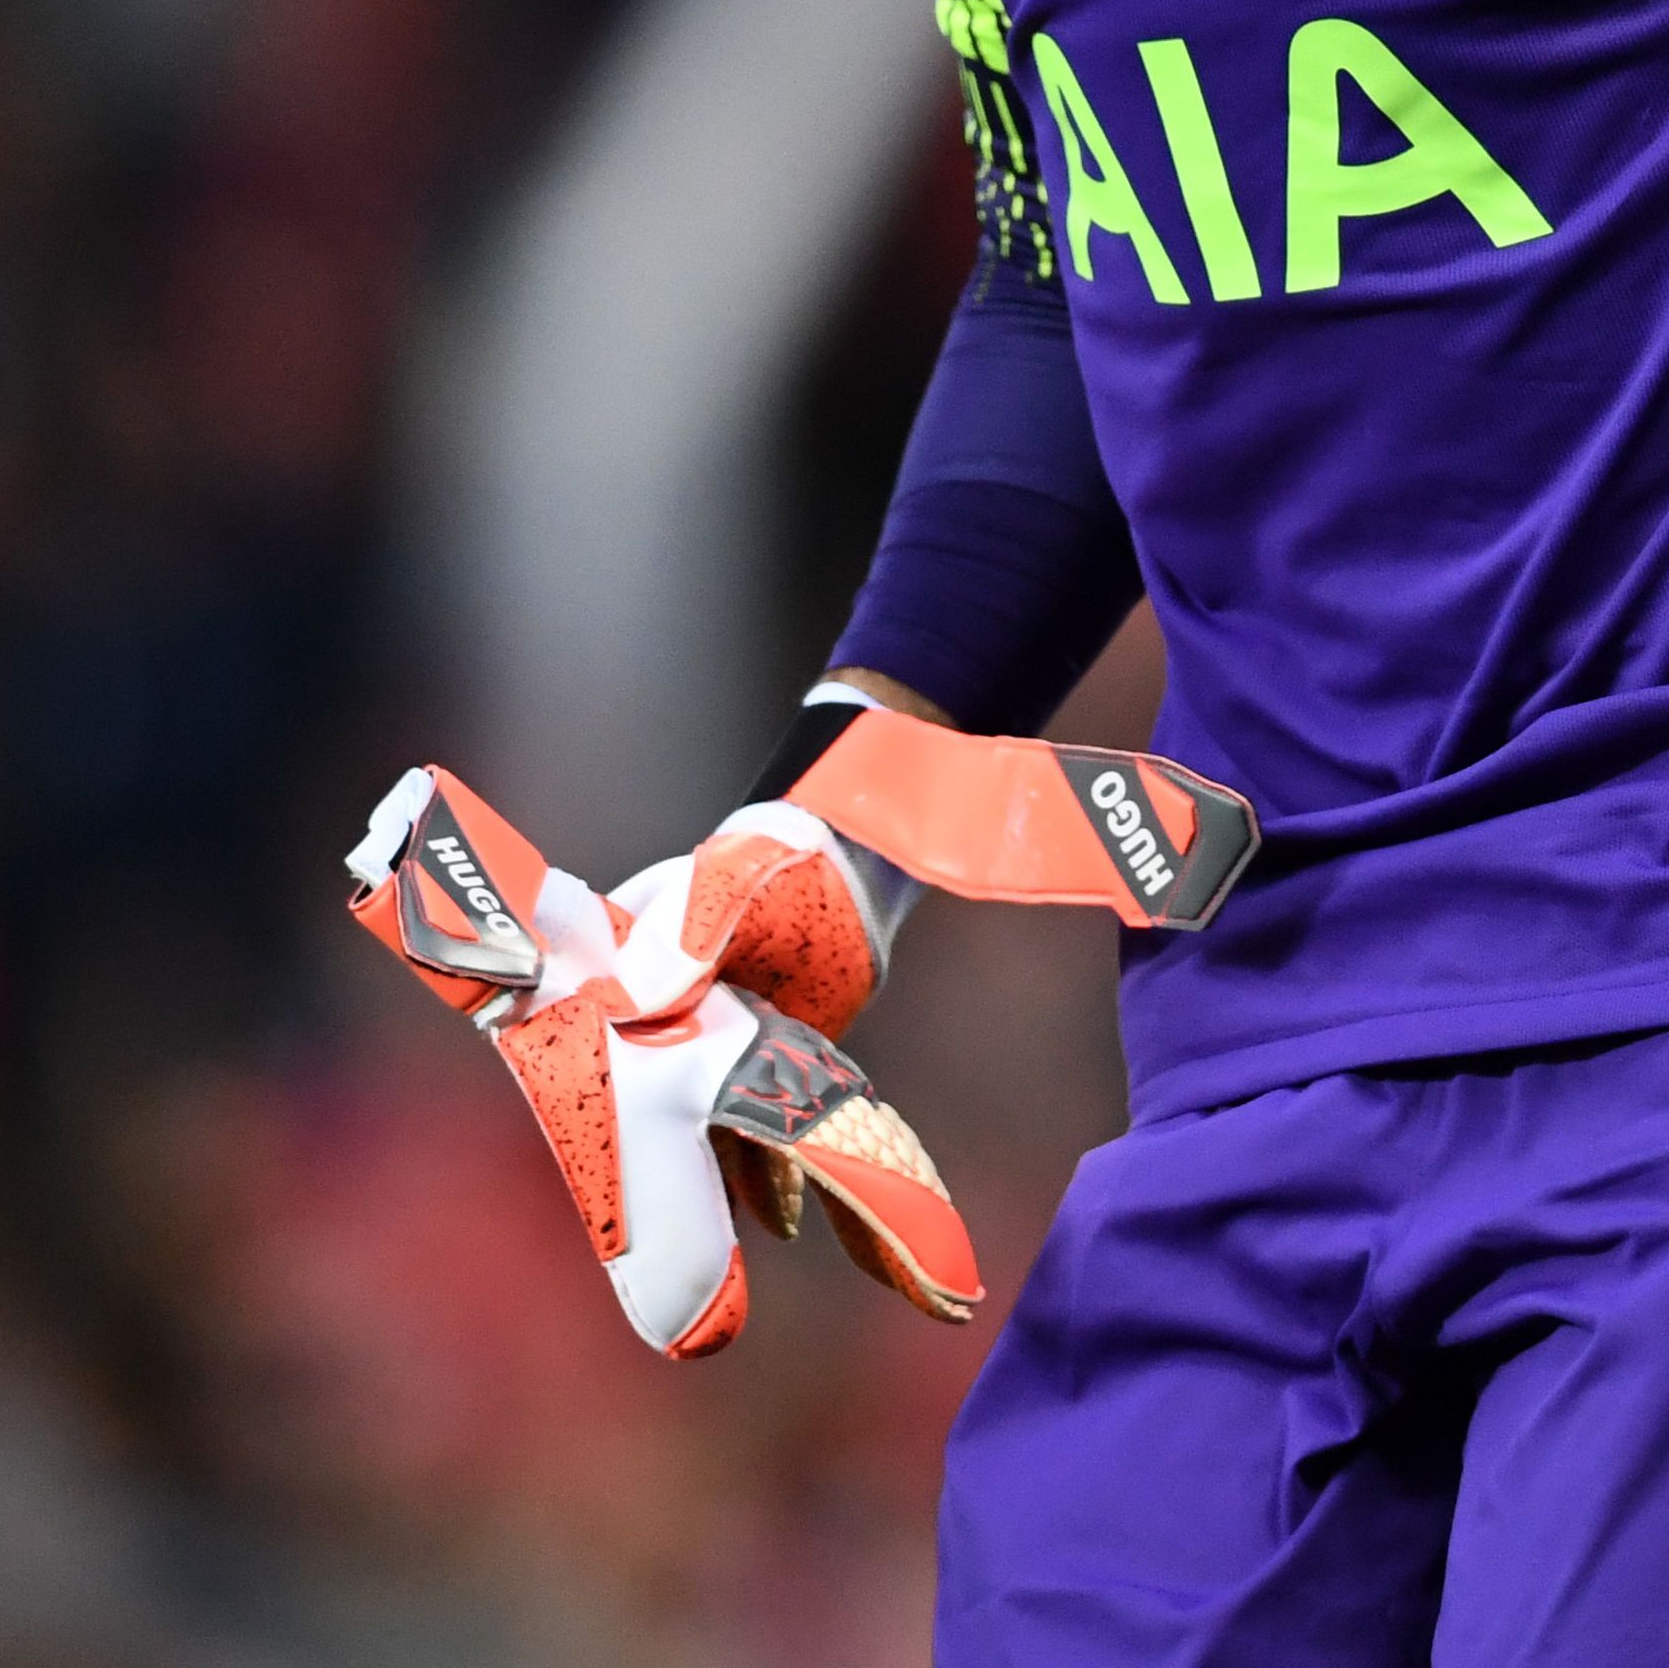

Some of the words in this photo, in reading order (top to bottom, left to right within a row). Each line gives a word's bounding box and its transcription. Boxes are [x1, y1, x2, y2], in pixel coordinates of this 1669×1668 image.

[1032, 18, 1554, 305] AIA
[427, 835, 521, 938] HUGO
[1090, 770, 1175, 897] HUGO
